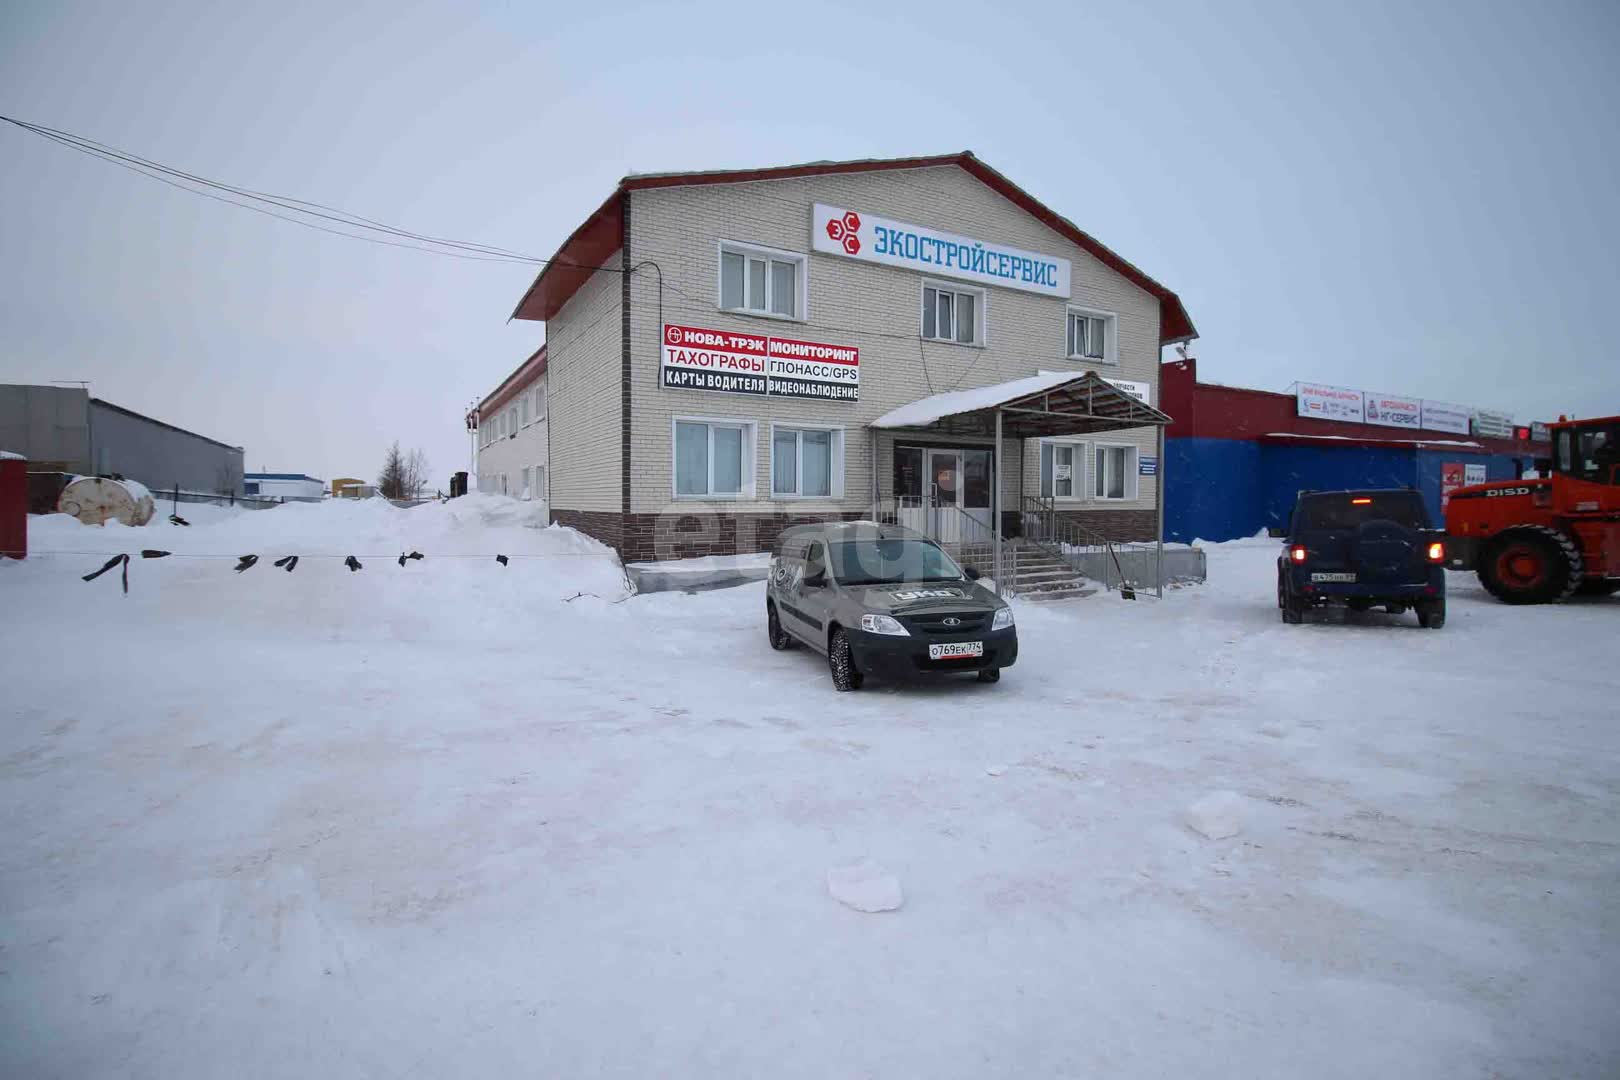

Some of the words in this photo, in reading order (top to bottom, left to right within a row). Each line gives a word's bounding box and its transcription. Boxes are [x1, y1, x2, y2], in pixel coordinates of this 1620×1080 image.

[874, 226, 1057, 287] ЭКОСТРОЙСЕРВИС
[684, 331, 765, 351] НОВА-ТРЭК
[770, 341, 857, 361] МОНИТОРИНГ
[667, 349, 765, 372] ТАХОГРАФЫ
[770, 361, 857, 380] ГЛОНАСС/GPS
[666, 371, 705, 387] КАРТЫ
[707, 374, 765, 391] ВОДИТЕЛЯ
[769, 380, 858, 399] ВИДЕОНАБЛЮДЕНИЕ
[1486, 487, 1529, 497] DISD
